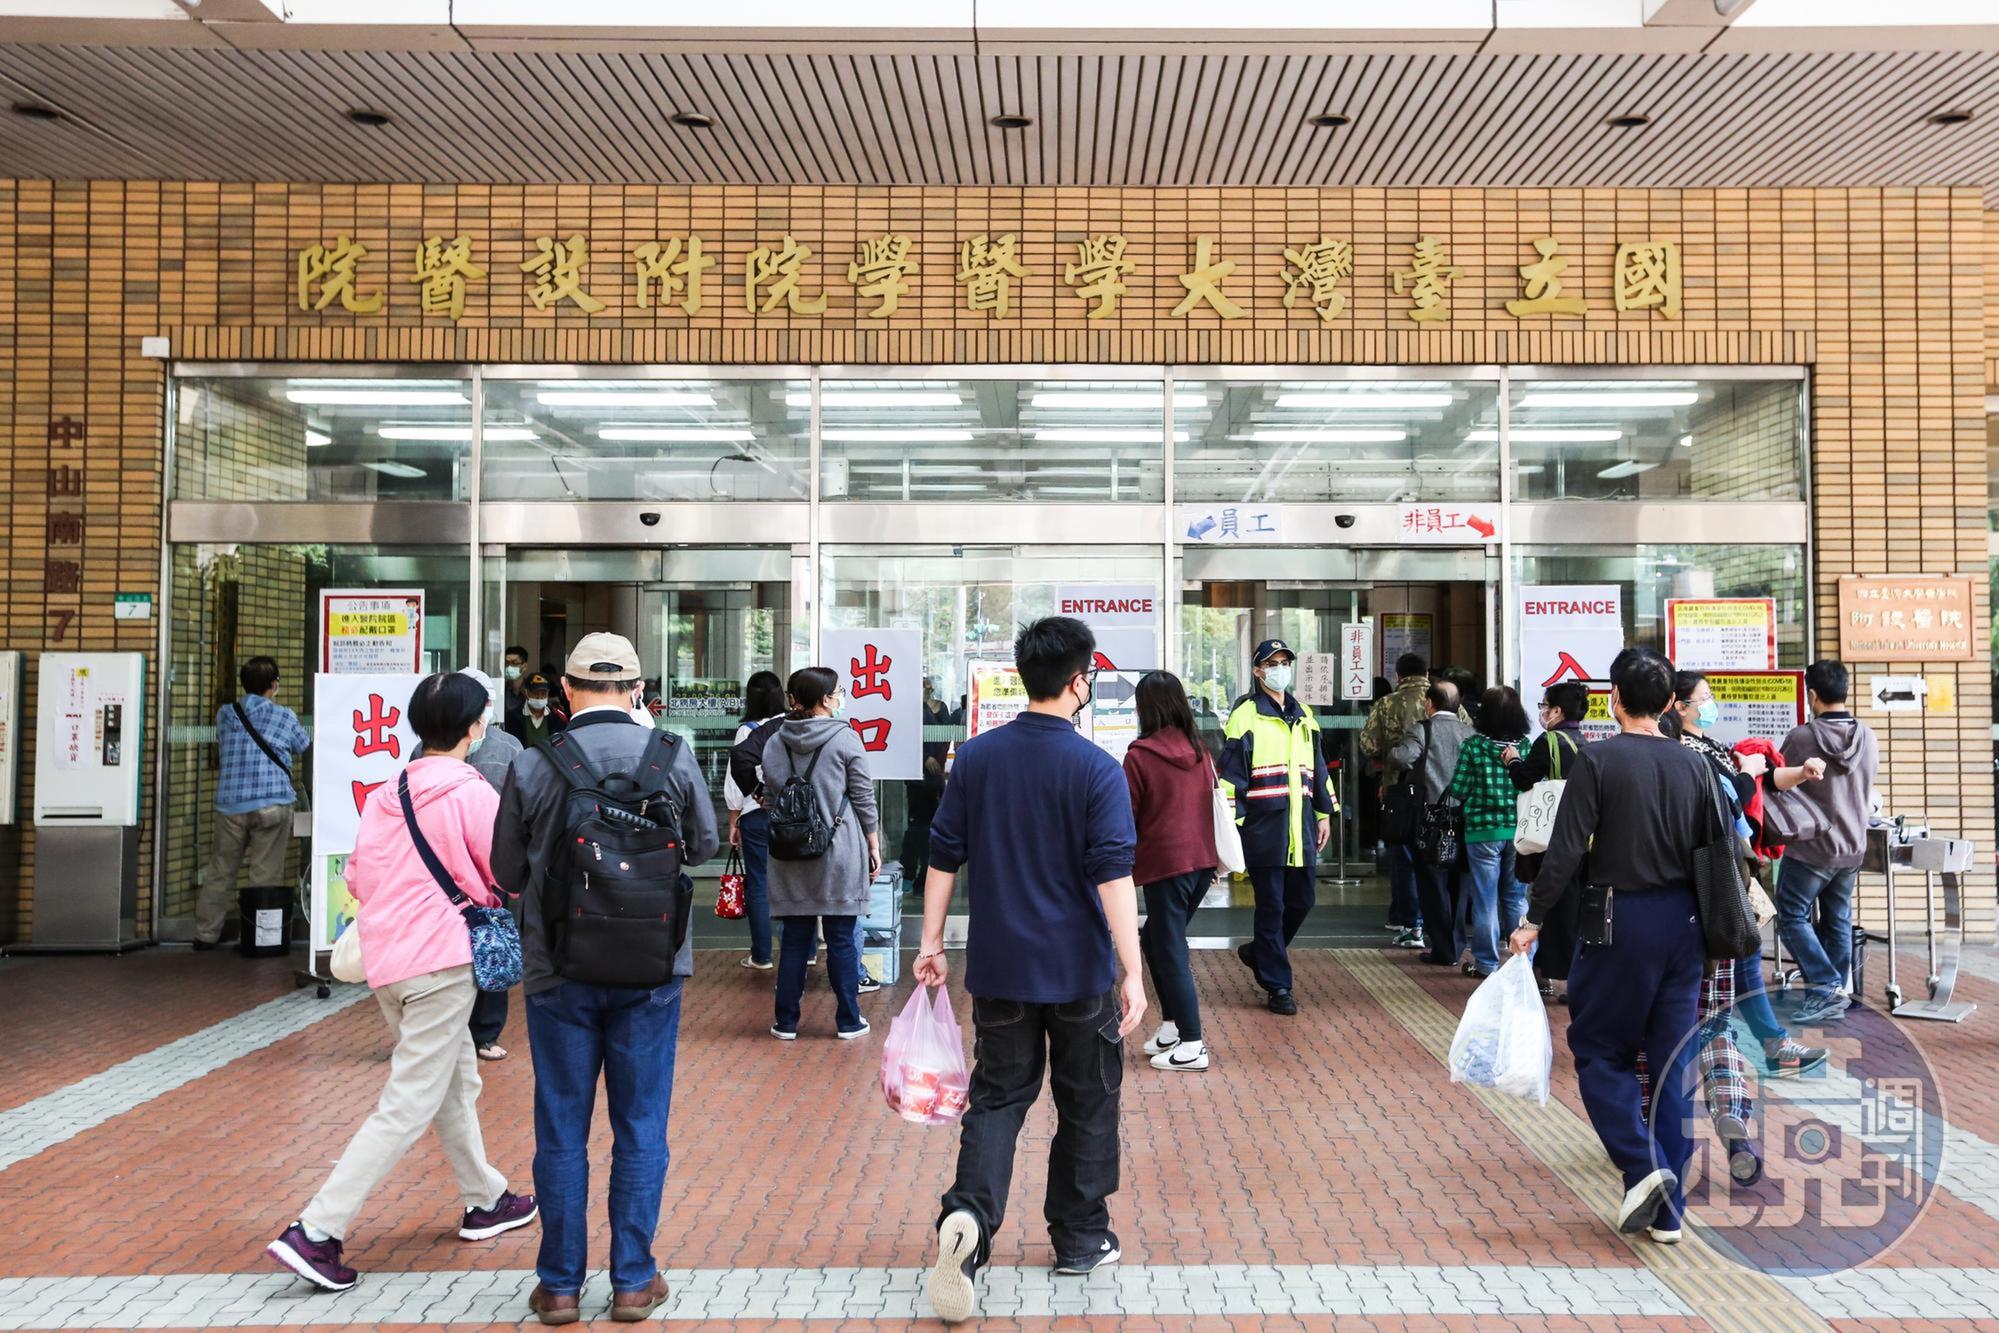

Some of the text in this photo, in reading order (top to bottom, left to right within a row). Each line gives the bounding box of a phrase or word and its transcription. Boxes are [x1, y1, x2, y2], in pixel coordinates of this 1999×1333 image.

[1219, 508, 1275, 539] 員工
[1404, 509, 1466, 534] 非員工
[127, 605, 137, 616] 7
[1061, 598, 1152, 614] ENTRANCE
[1525, 601, 1615, 615] ENTRANCE
[1850, 608, 1964, 629] 附設醫院
[1350, 629, 1365, 695] 非員工入口
[850, 644, 892, 753] 出口
[1590, 697, 1609, 707] 進入
